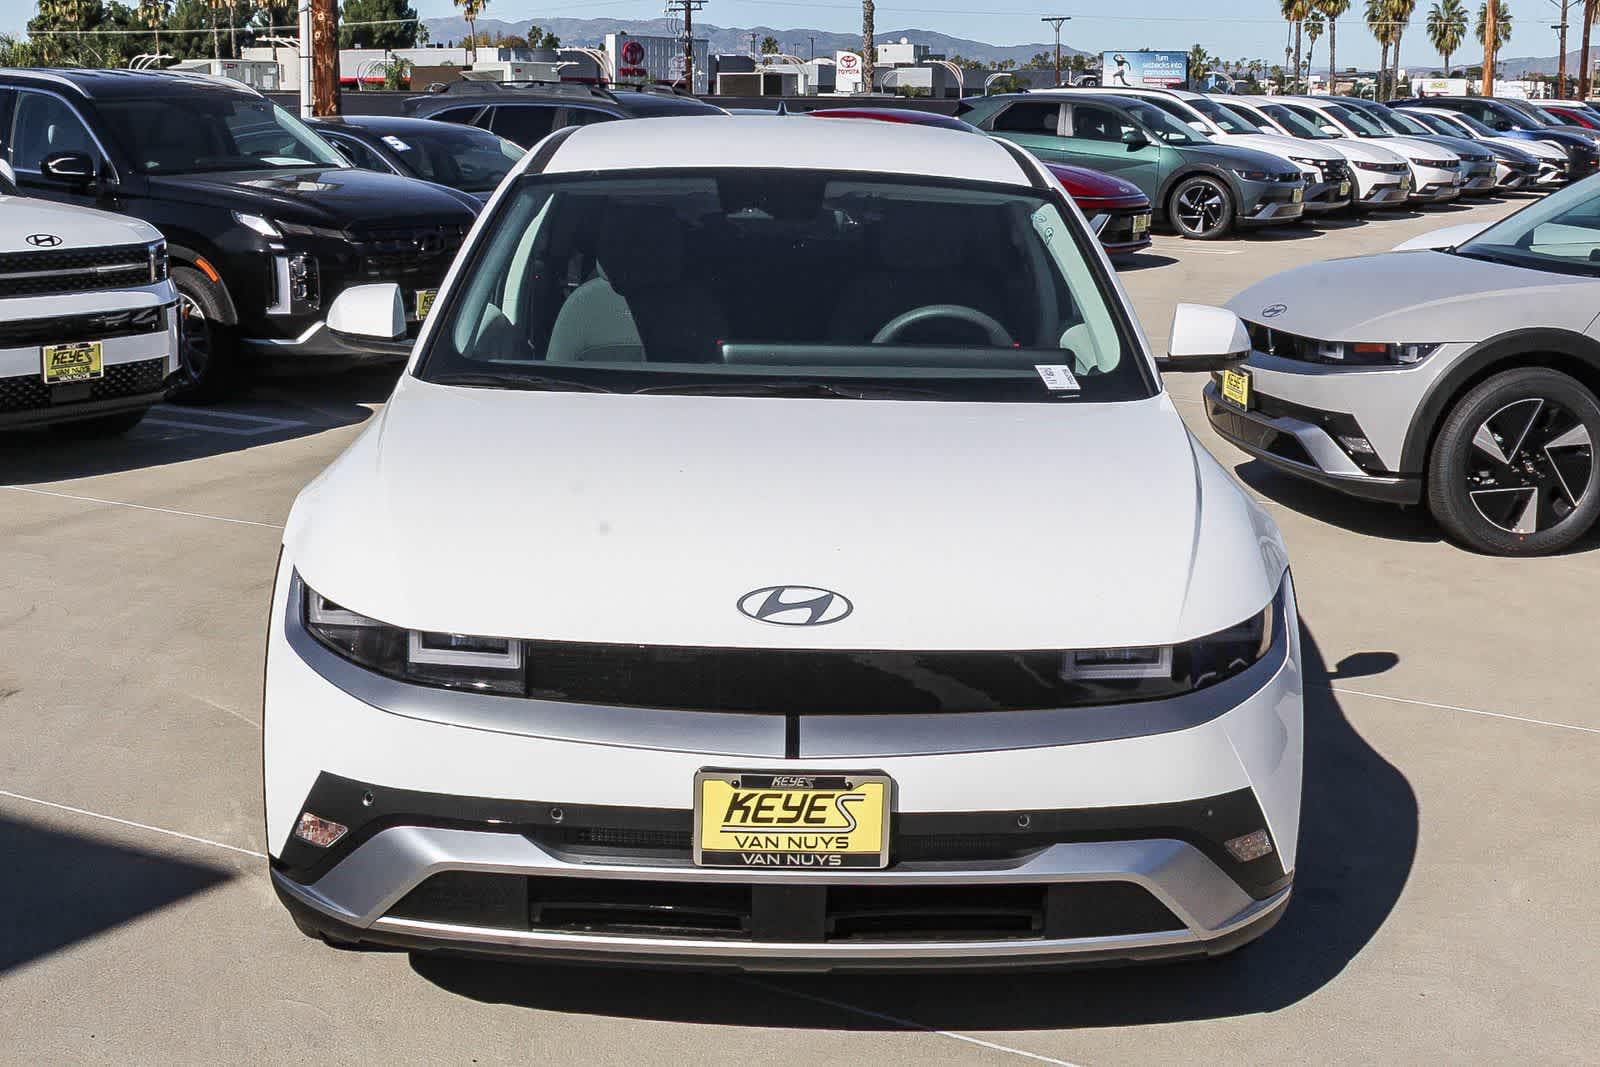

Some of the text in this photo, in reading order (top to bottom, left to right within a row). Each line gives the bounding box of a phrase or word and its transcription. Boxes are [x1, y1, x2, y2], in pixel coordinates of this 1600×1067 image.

[51, 348, 95, 368] KEYES
[771, 776, 815, 787] KEYES
[721, 793, 866, 833] KEYES
[734, 835, 849, 849] VAN NUYS
[742, 853, 842, 866] VAN NUYS
